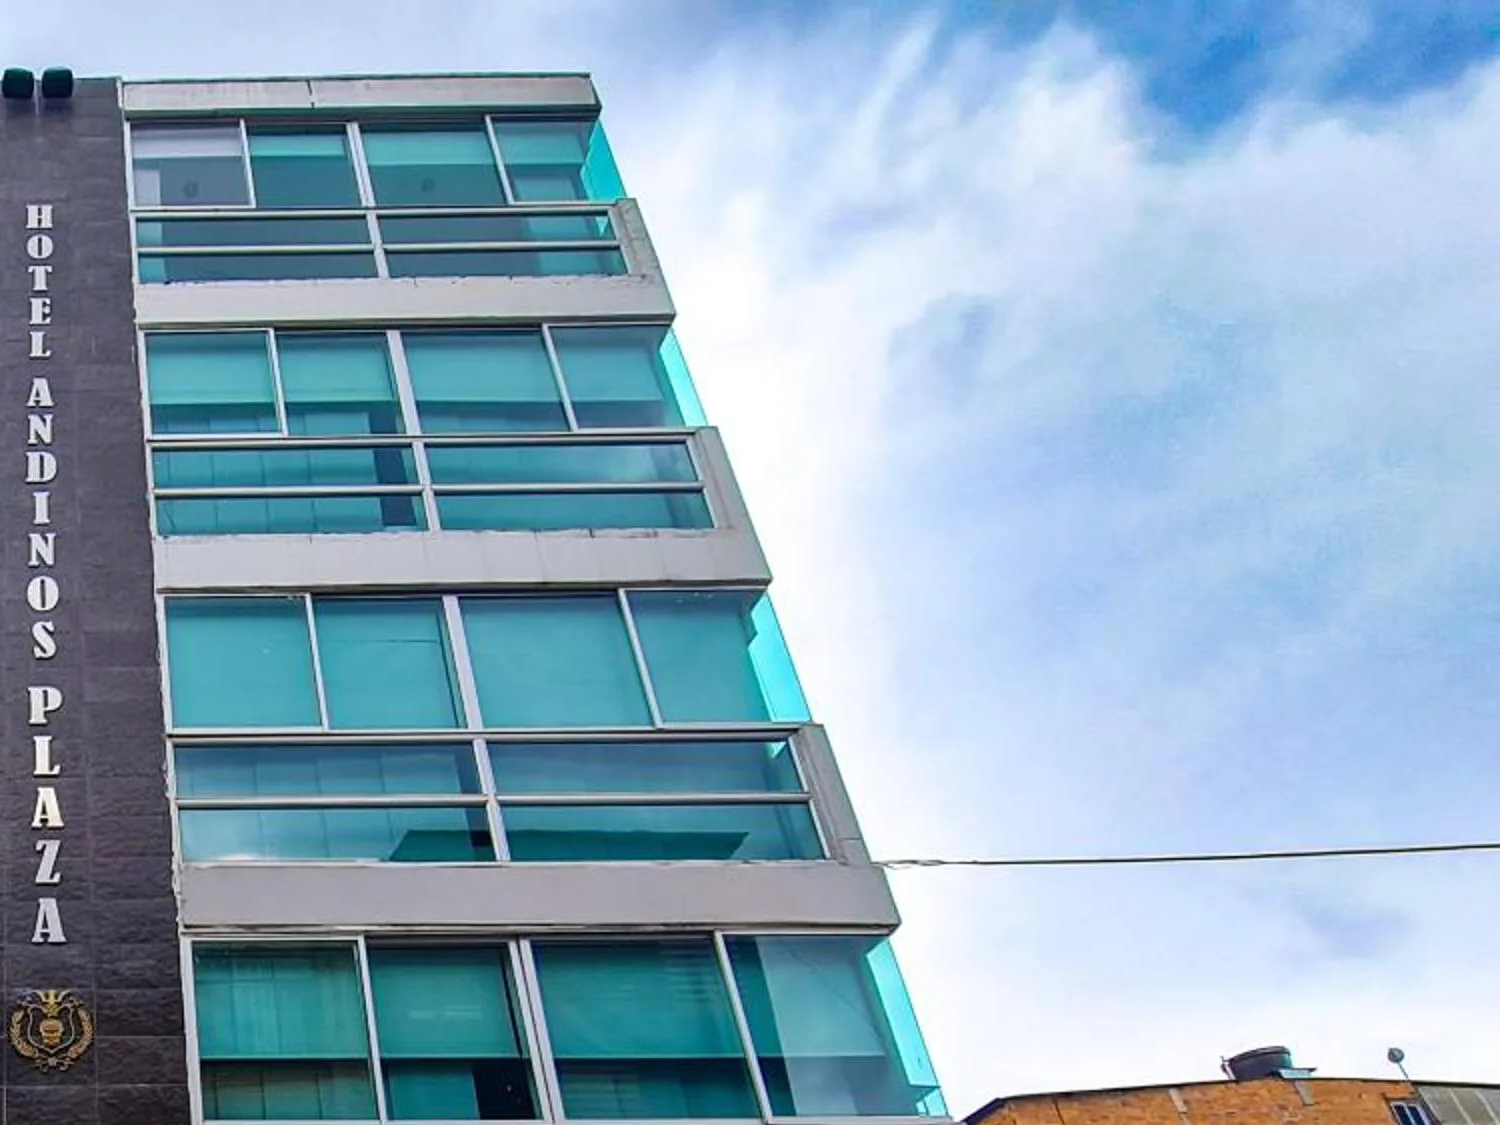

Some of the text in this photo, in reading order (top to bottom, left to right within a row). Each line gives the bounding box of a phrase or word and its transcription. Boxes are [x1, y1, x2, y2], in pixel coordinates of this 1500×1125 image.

[25, 204, 67, 943] HOTEL ANDINOS PLAZA
